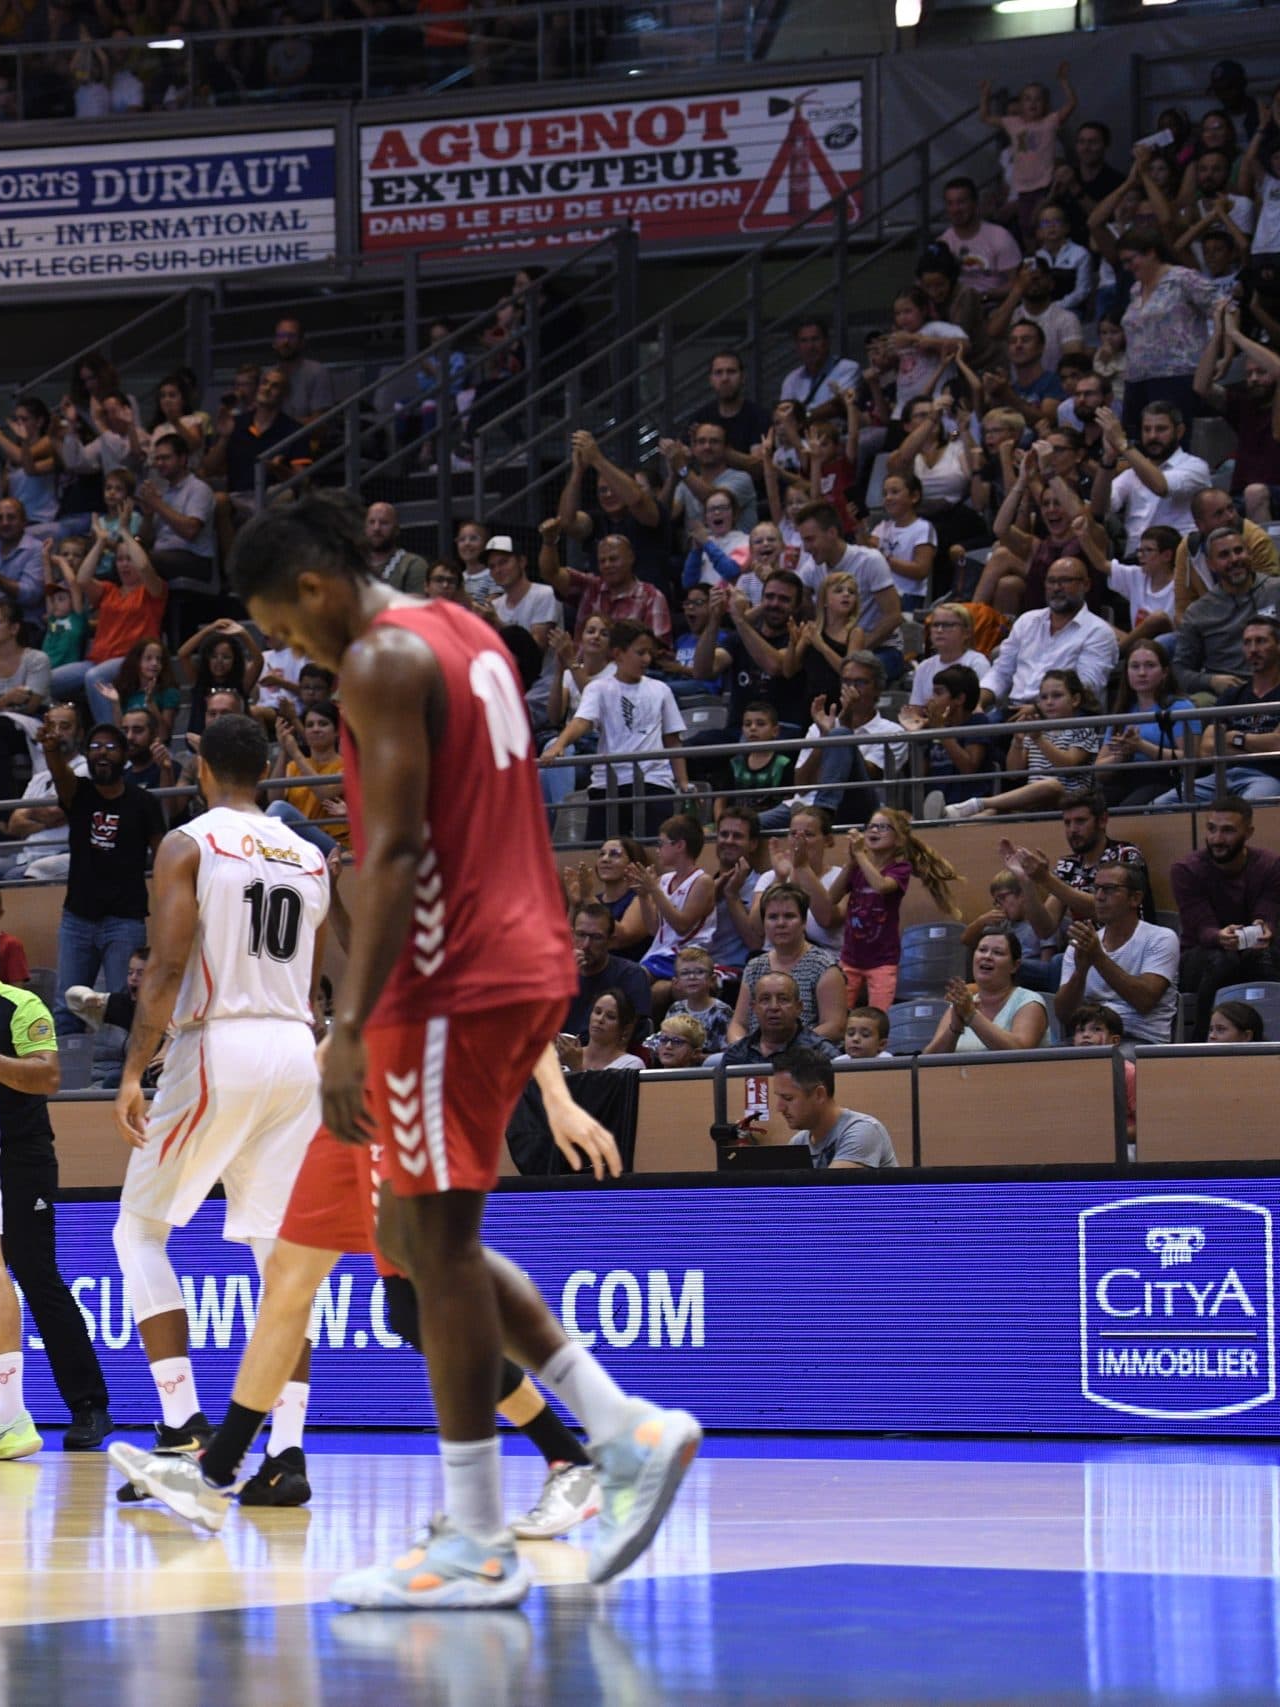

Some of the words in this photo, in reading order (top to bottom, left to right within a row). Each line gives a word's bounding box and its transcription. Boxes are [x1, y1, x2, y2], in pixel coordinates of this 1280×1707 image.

[368, 100, 740, 170] AGUENOT
[91, 154, 309, 207] DURIAUT
[370, 146, 741, 206] EXTINCTEUR
[55, 209, 308, 246] INTERNATIONAL
[369, 214, 446, 236] DANS
[457, 211, 490, 229] LE
[500, 204, 554, 225] FEU
[565, 200, 603, 219] DE
[612, 187, 742, 214] L'ACTION
[242, 878, 304, 963] 10
[1097, 1348, 1259, 1377] IMMOBILIER
